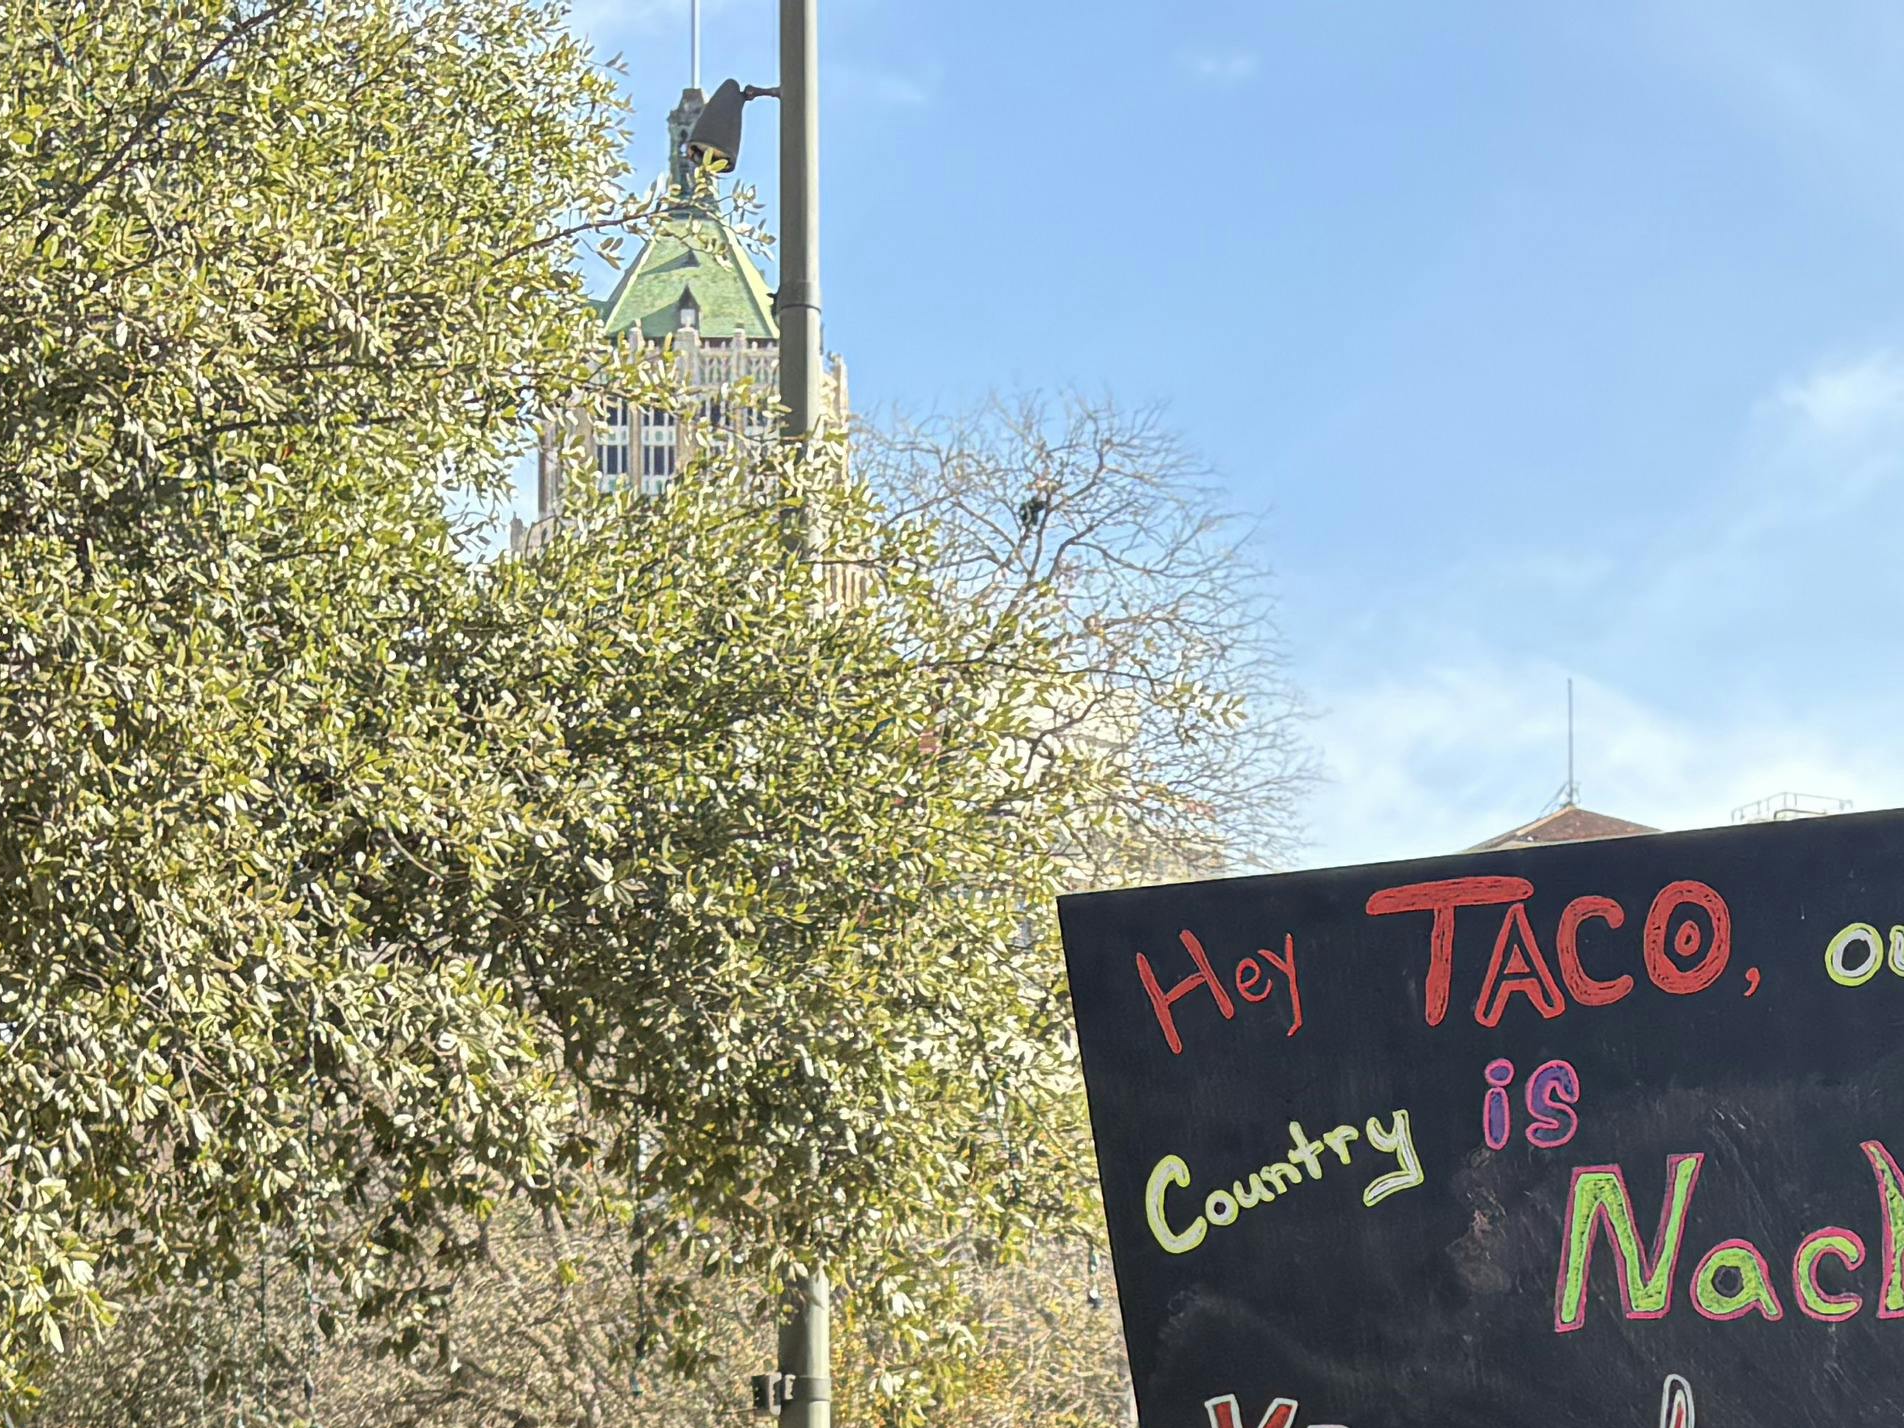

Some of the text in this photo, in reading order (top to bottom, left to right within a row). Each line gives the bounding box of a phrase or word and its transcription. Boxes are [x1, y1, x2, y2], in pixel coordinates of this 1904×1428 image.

[1136, 930, 1303, 1055] Hey
[1364, 875, 1762, 1028] TACO,
[1144, 1057, 1579, 1253] Country is
